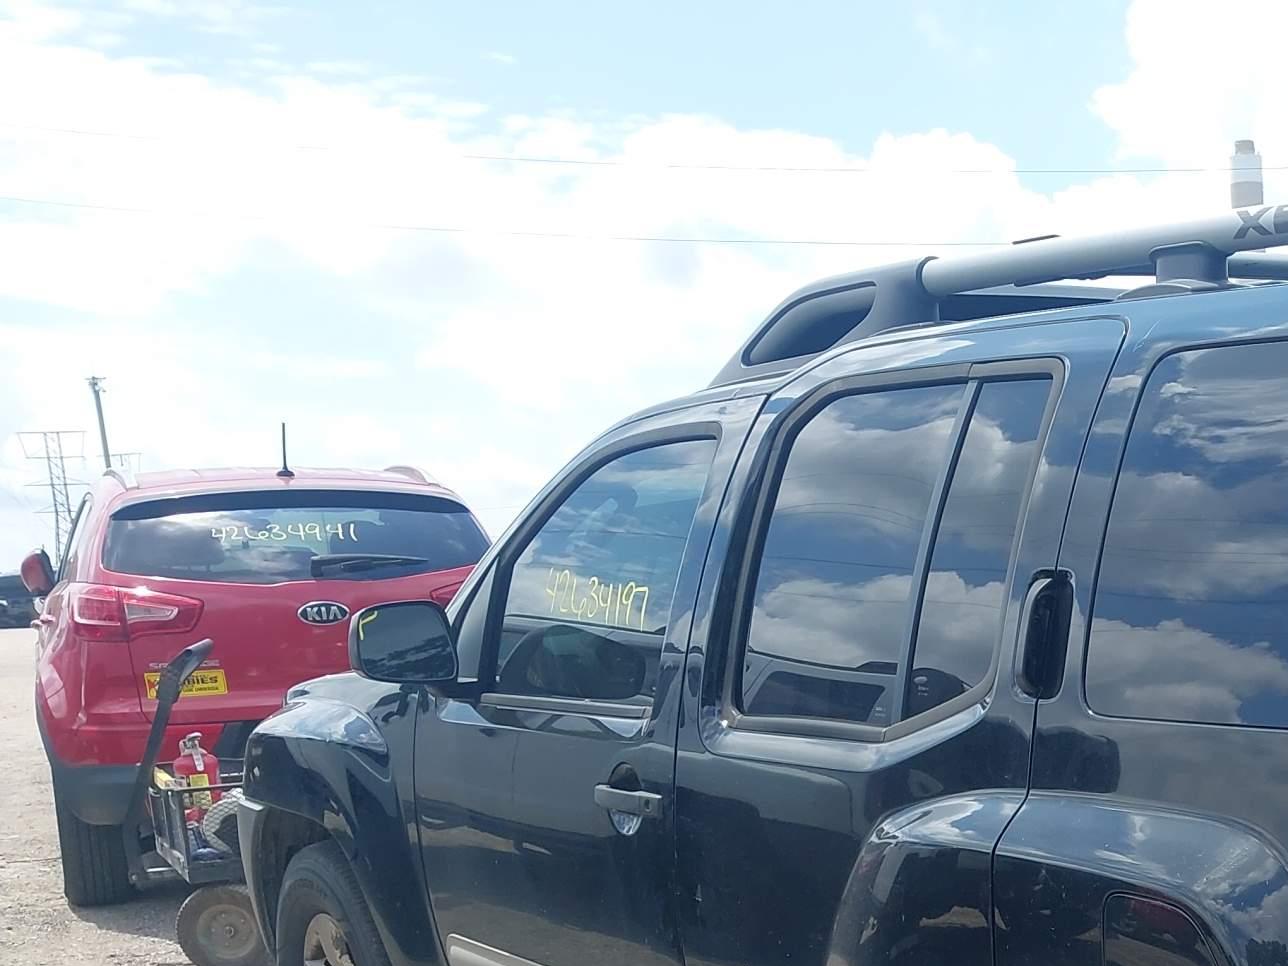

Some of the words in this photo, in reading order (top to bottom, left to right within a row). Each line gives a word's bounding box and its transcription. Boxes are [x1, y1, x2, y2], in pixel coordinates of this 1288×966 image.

[211, 523, 358, 541] 42634941
[545, 567, 649, 632] 42634197
[306, 606, 342, 621] KIA
